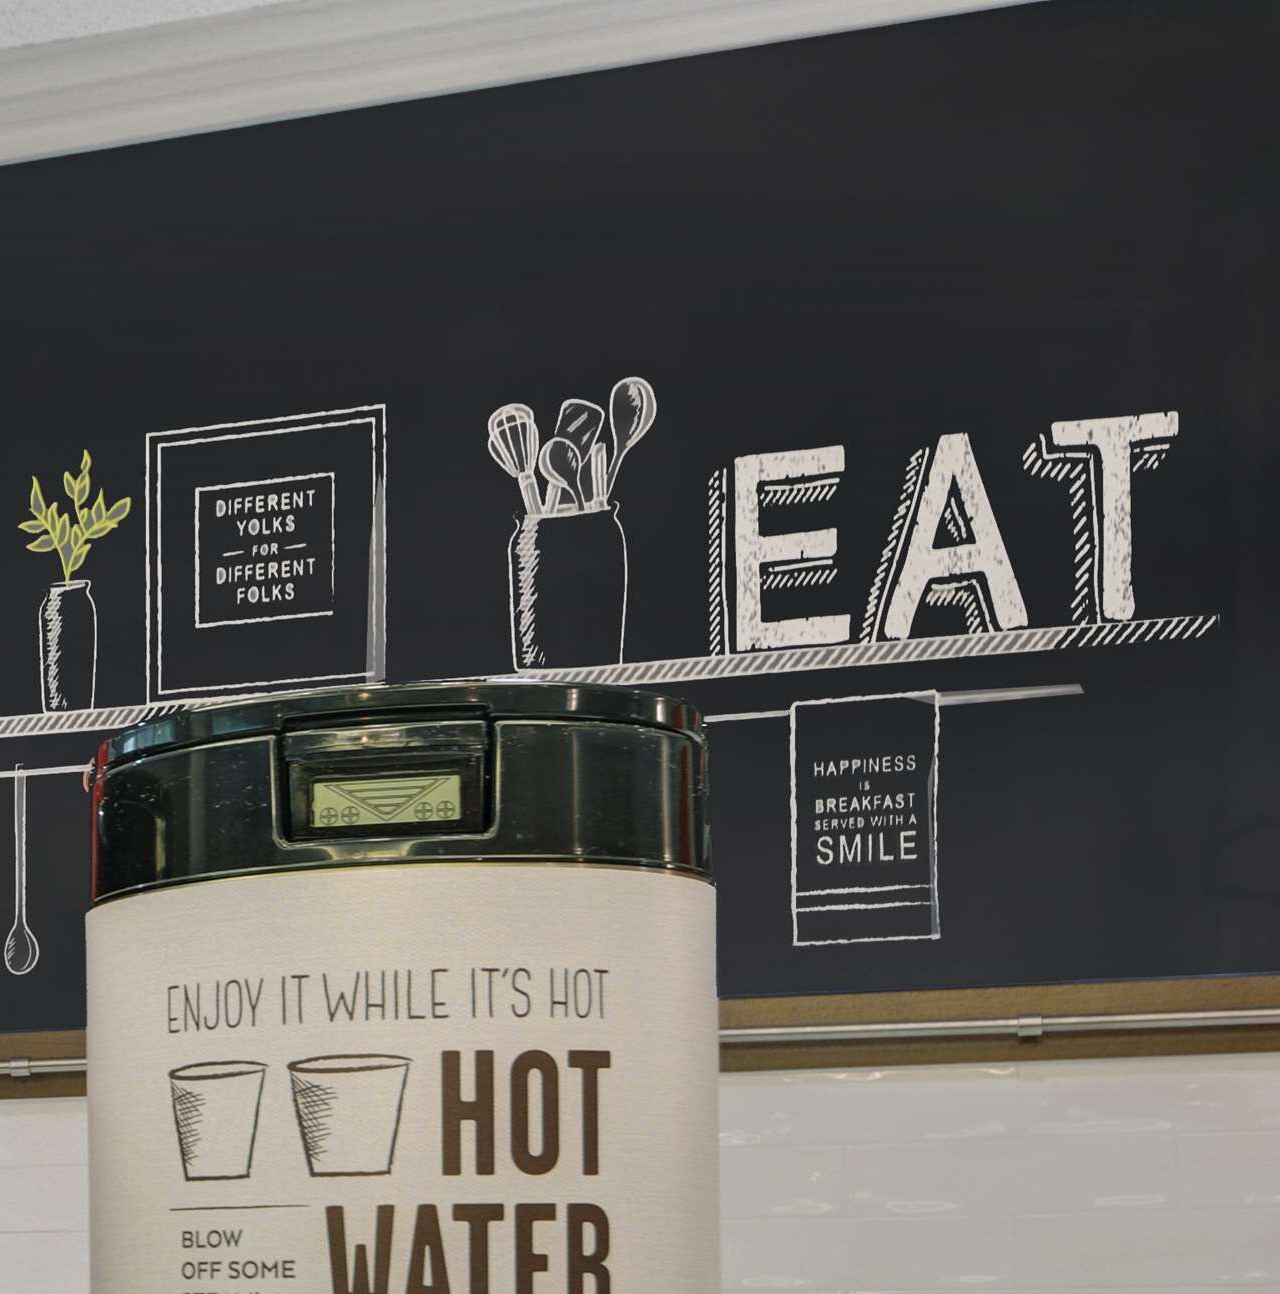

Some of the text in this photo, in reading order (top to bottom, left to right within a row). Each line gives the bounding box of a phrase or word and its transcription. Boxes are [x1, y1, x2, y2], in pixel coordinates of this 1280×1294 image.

[216, 489, 315, 517] DIFFERENT
[237, 514, 295, 537] YOLKS
[709, 411, 1179, 656] EAT
[252, 543, 278, 557] FOR
[216, 558, 315, 585] DIFFERENT
[237, 583, 294, 605] FOLKS
[814, 755, 917, 776] HAPPINESS
[859, 780, 871, 791] IS
[815, 793, 916, 814] BREAKFAST
[814, 814, 918, 831] SERVED WITH A
[816, 830, 918, 865] SMILE
[167, 967, 610, 1034] ENJOY IT WHILE IT'S HOT
[441, 1049, 611, 1176] HOT
[182, 1229, 242, 1248] BLOW
[181, 1260, 296, 1279] OFF SOME
